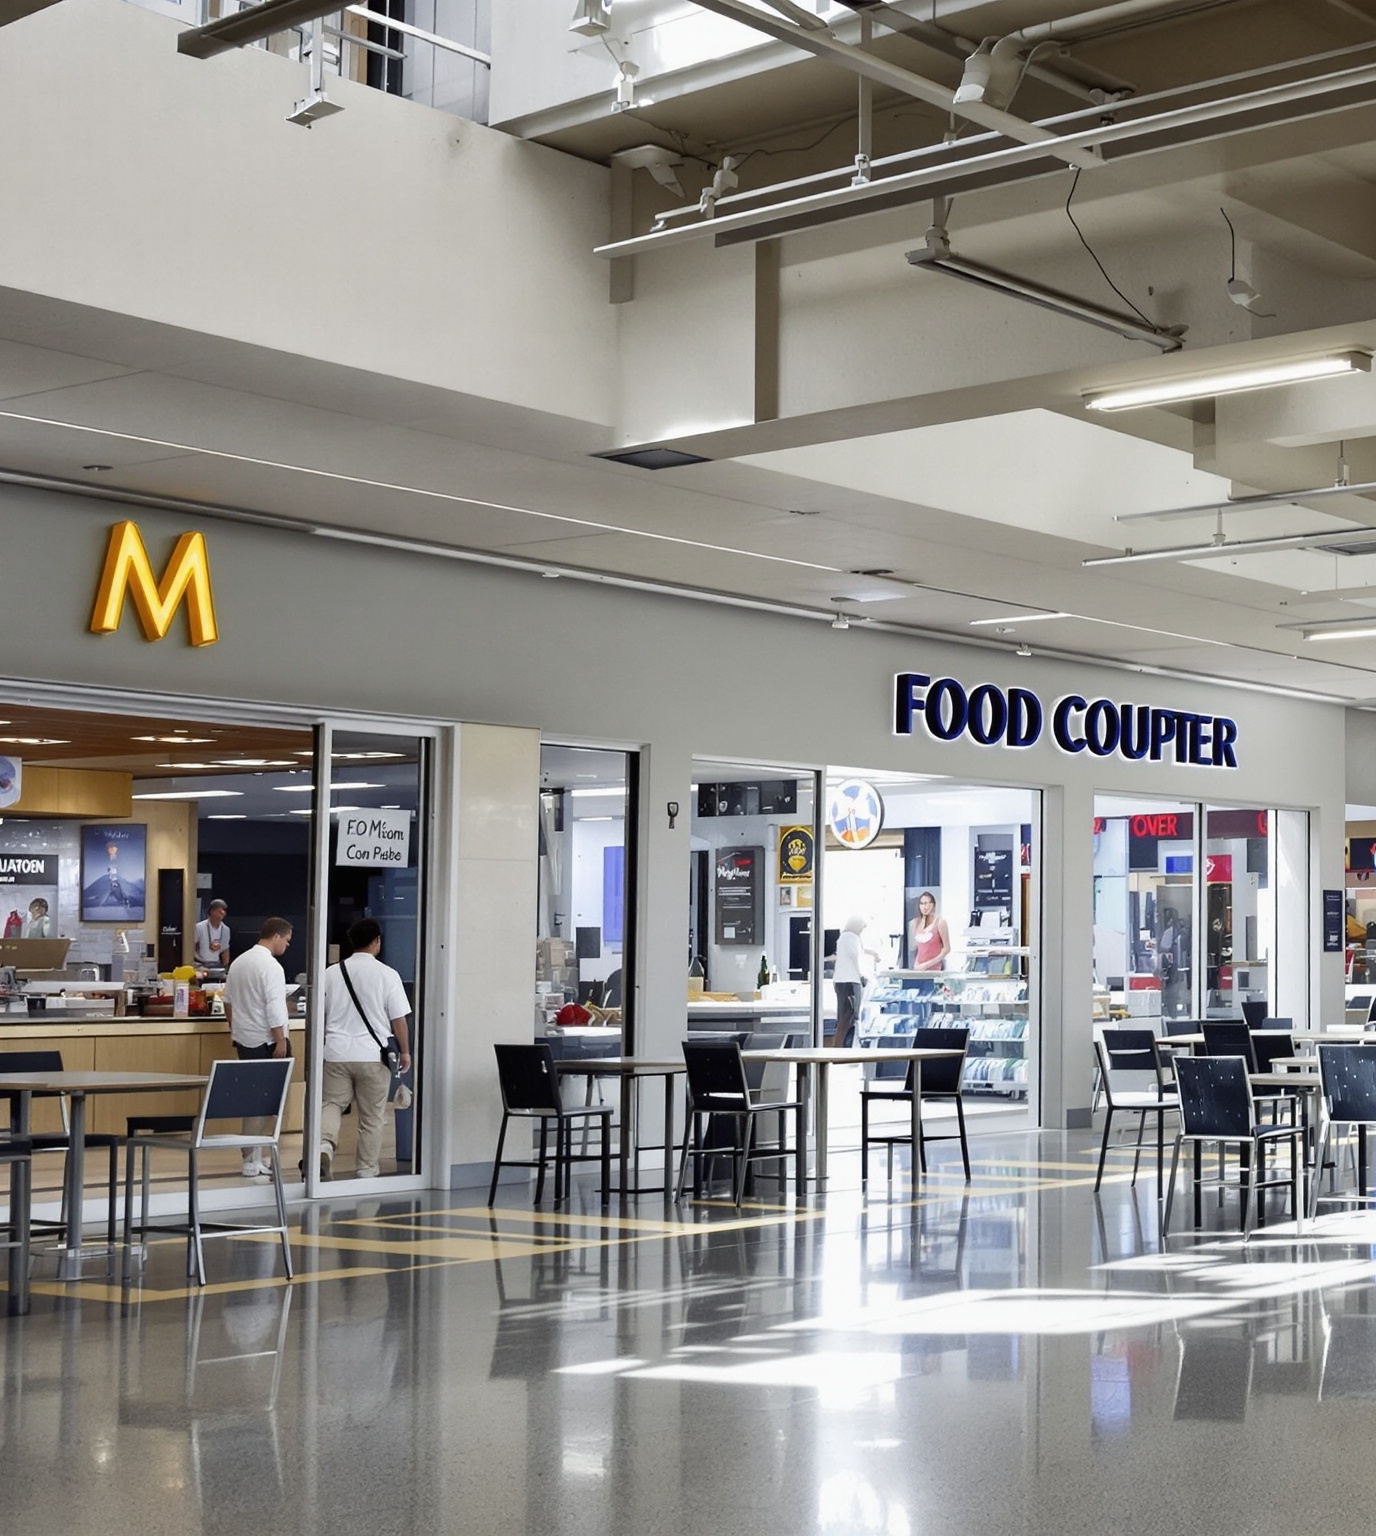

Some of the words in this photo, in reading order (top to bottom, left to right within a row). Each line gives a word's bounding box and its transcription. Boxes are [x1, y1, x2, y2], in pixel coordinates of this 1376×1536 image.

[88, 519, 219, 647] M
[896, 673, 1042, 747] FOOD
[1053, 694, 1238, 768] COUPTER
[1131, 814, 1178, 836] OVER
